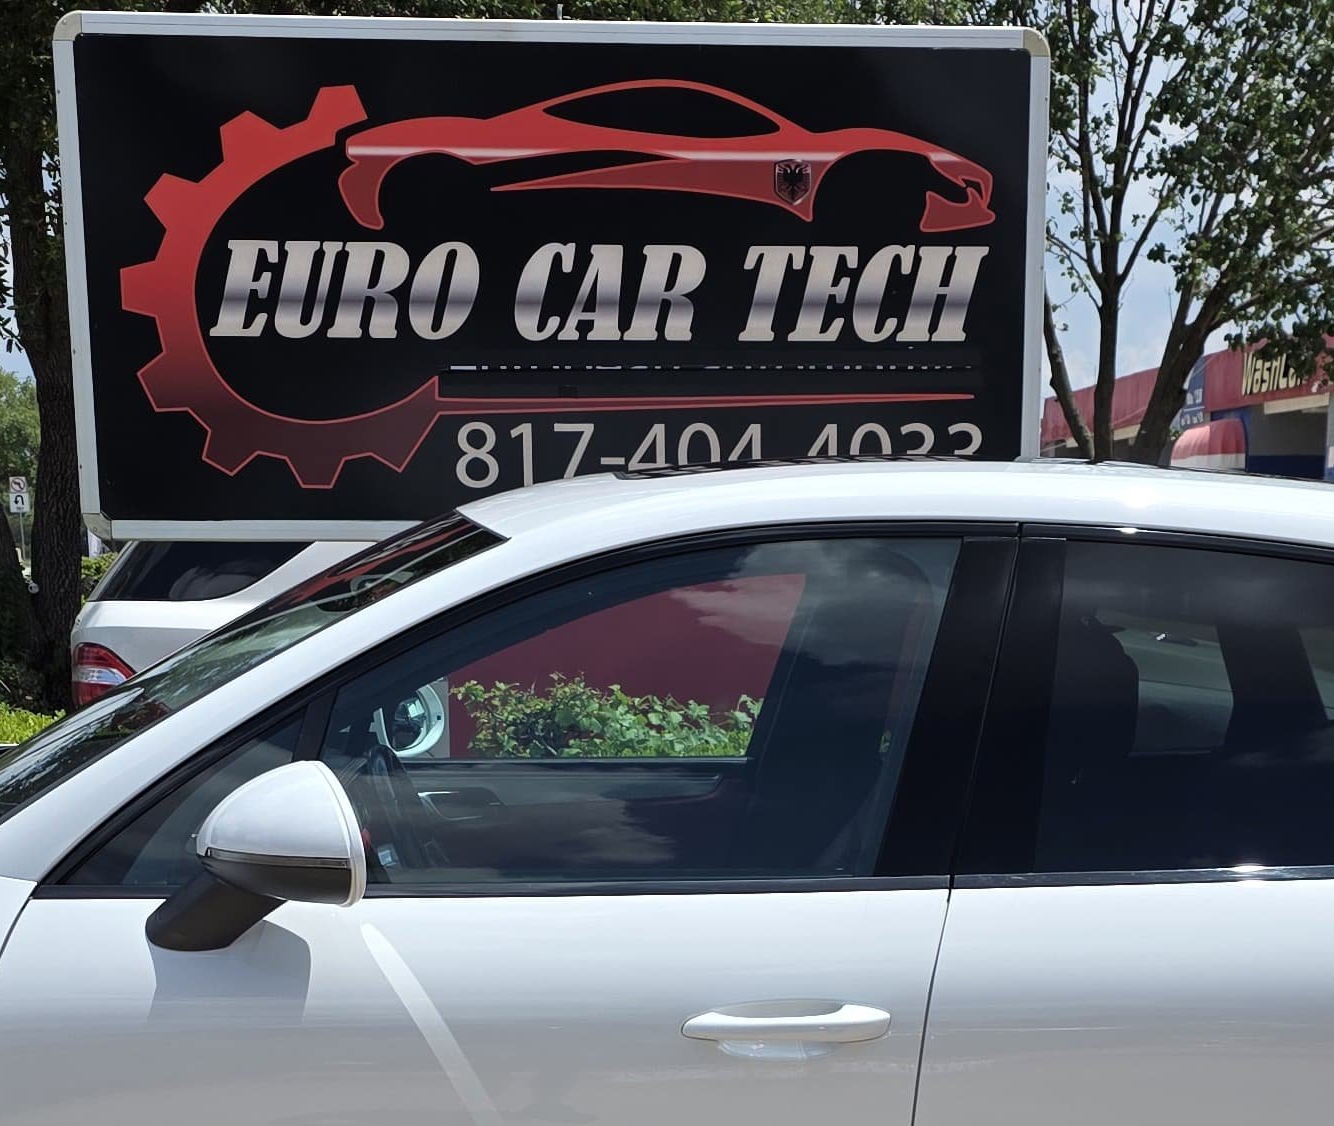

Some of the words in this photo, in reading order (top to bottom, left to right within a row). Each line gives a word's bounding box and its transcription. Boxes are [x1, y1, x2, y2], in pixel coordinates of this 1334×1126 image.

[209, 239, 480, 340] EURO
[514, 242, 707, 341] CAR
[738, 244, 990, 343] TECH
